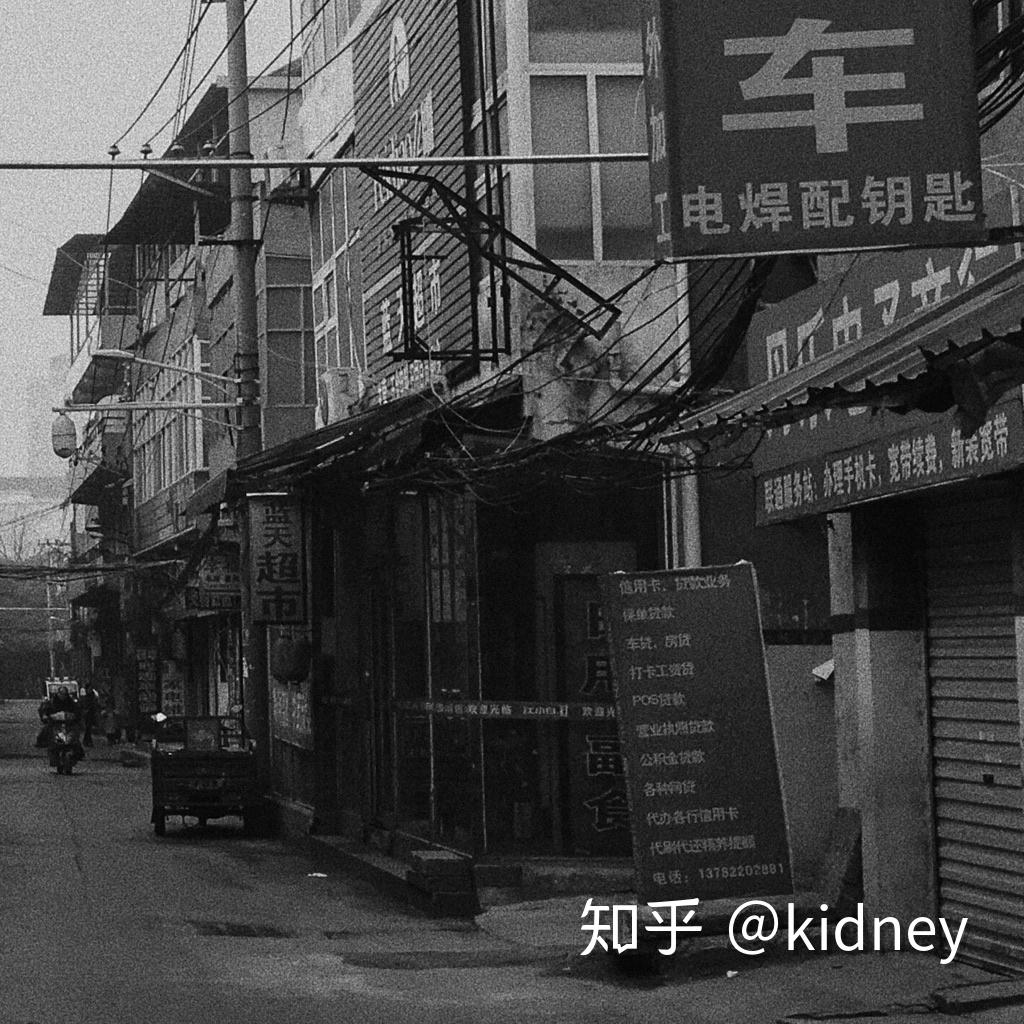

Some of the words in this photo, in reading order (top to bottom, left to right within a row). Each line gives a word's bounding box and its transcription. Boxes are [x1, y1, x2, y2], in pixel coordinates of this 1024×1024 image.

[681, 170, 978, 238] 电焊配钥匙
[256, 502, 301, 620] 蓝天超市
[632, 692, 686, 707] POS贷款
